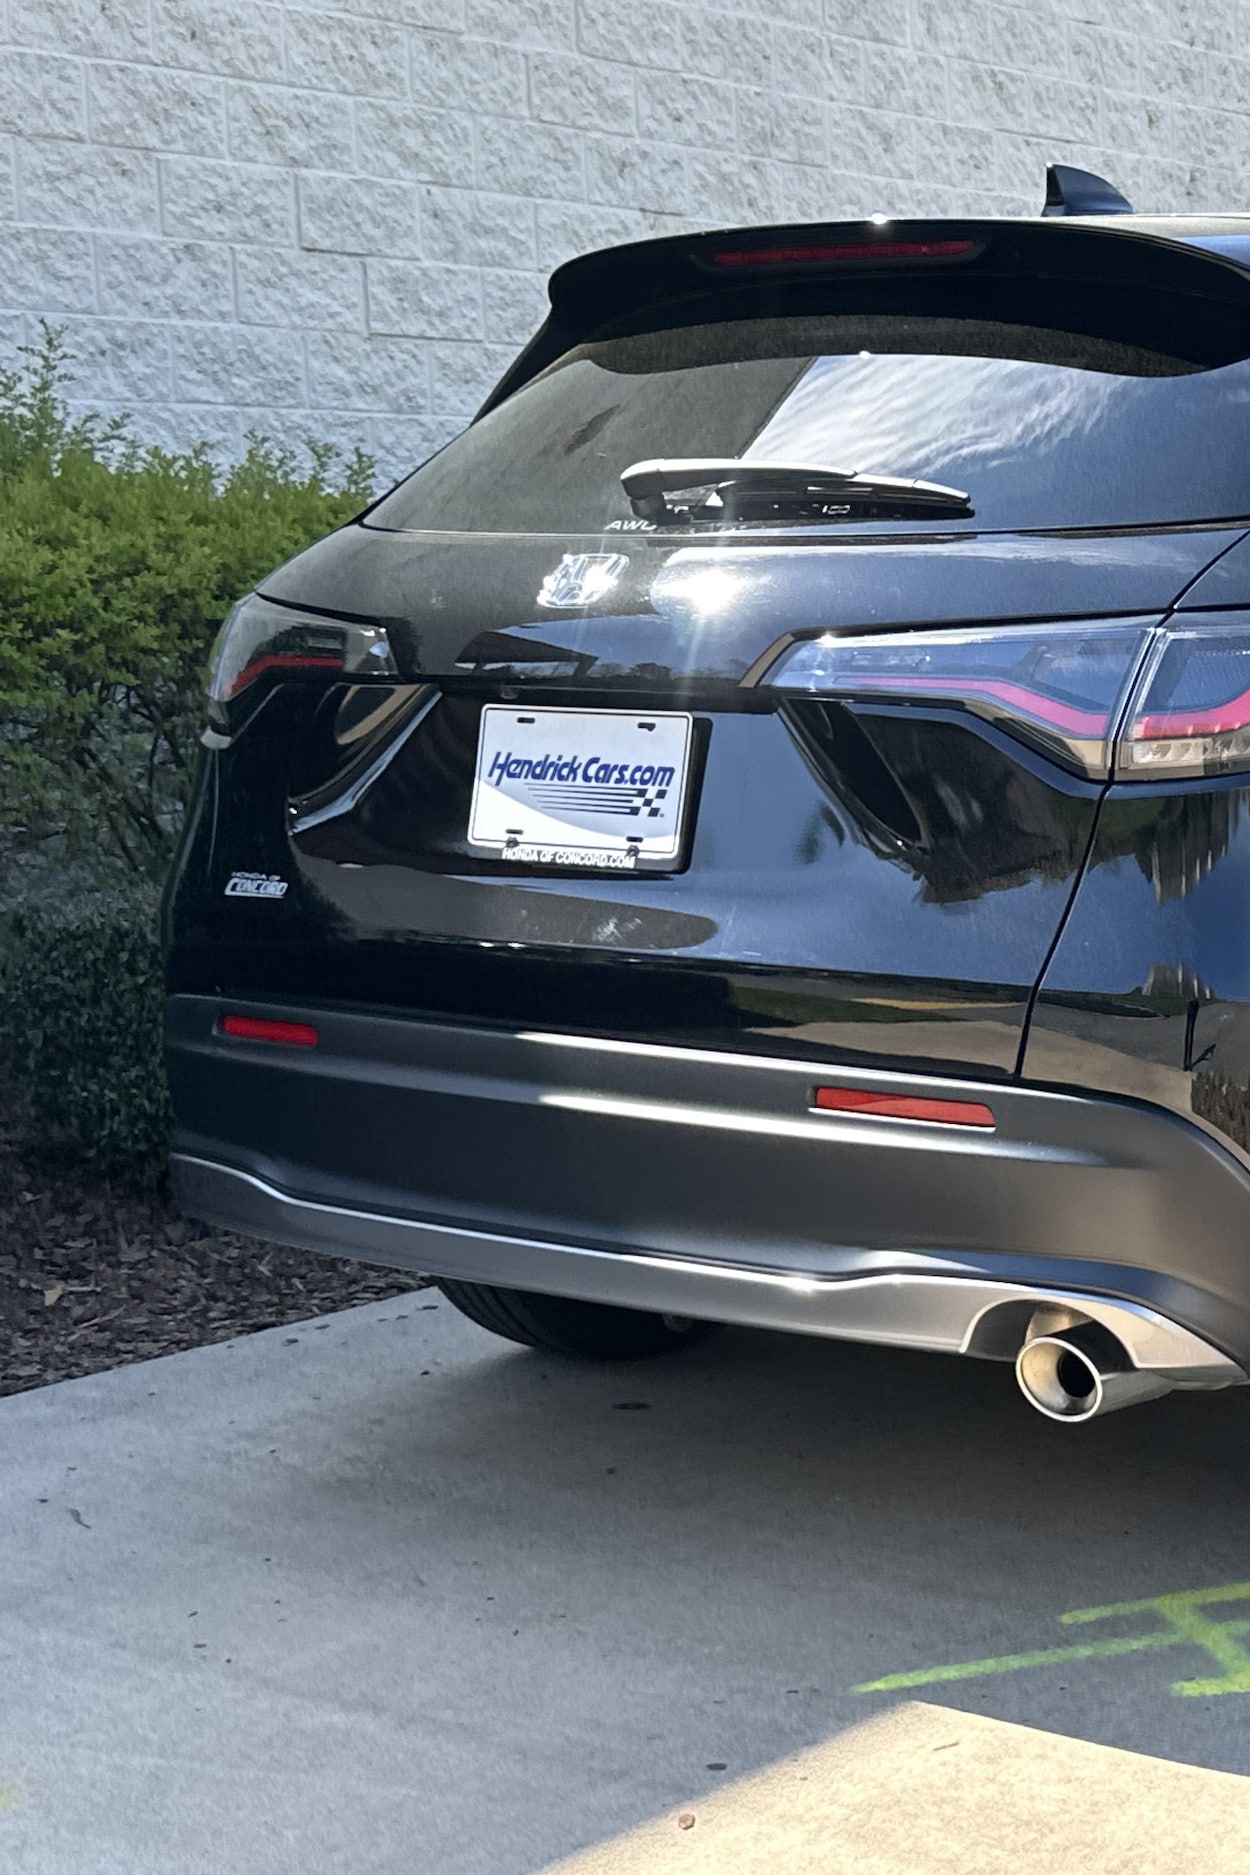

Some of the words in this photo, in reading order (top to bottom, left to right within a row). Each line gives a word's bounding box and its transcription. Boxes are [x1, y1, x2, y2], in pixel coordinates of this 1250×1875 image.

[502, 846, 539, 862] HONDA
[540, 849, 555, 863] OF
[231, 871, 267, 880] HONDA
[224, 878, 288, 897] CONCORD
